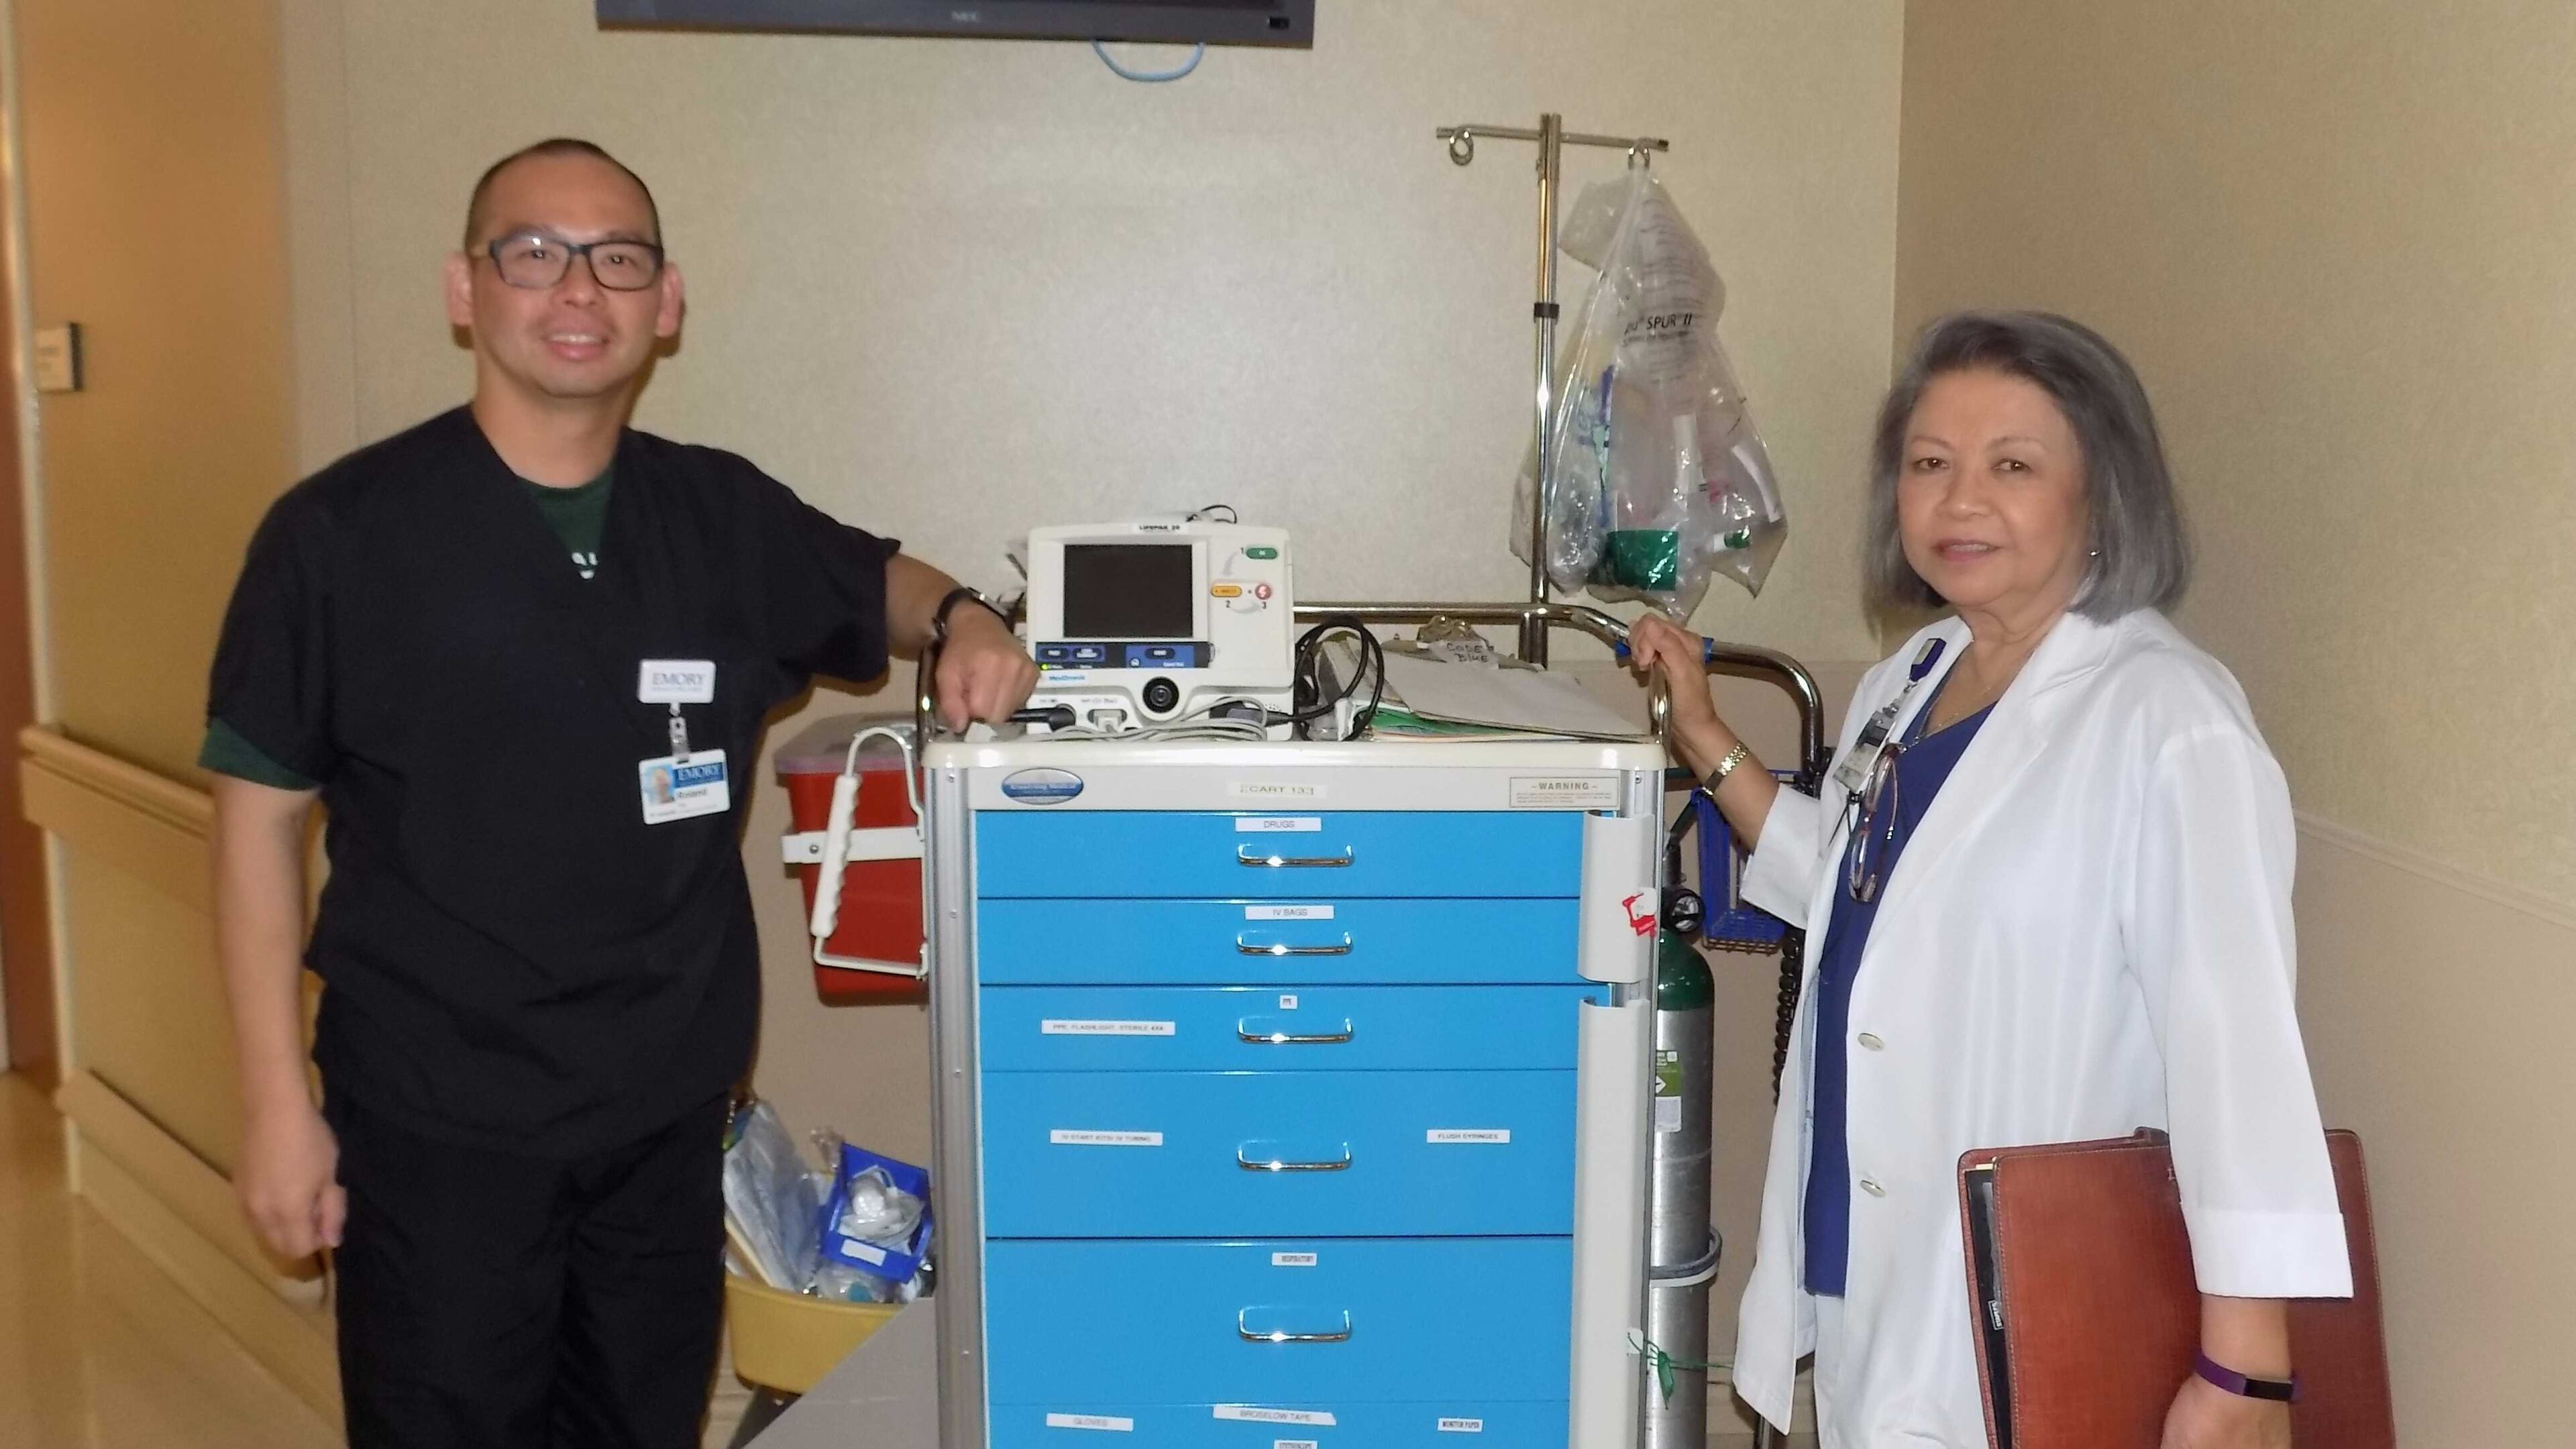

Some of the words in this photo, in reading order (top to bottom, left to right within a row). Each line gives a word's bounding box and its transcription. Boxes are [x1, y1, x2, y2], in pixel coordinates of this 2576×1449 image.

[1646, 313, 1676, 330] SPUR
[1683, 312, 1693, 326] II
[1240, 547, 1244, 555] 1
[1225, 600, 1231, 608] 2
[1262, 601, 1267, 609] 3
[652, 672, 704, 686] EMORY
[678, 764, 720, 780] EMORY
[1538, 782, 1589, 790] WARNING
[1263, 820, 1295, 828] DRUGS
